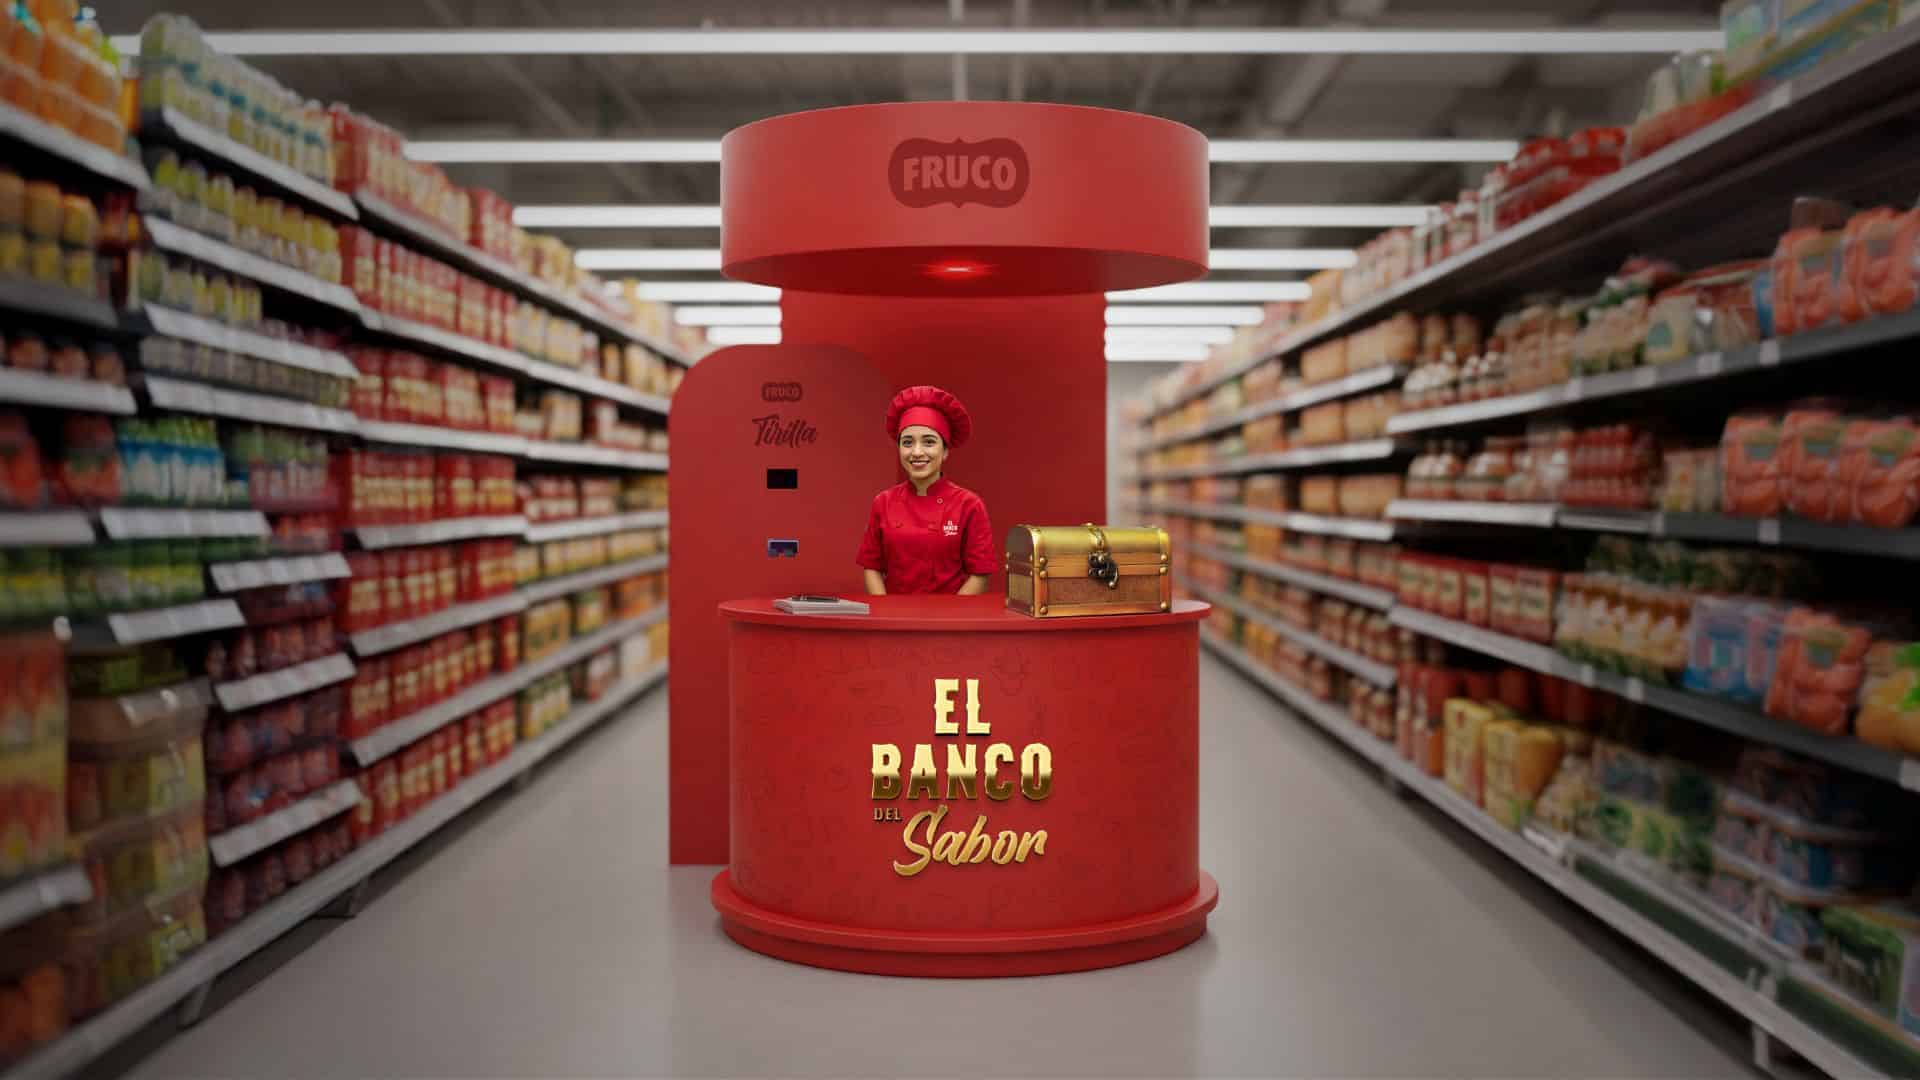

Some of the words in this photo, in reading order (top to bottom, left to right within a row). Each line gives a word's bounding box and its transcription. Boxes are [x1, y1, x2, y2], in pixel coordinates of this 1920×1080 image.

[904, 155, 1016, 191] FRUCO
[934, 678, 991, 735] EL
[871, 743, 1052, 799] BANCO
[874, 807, 901, 821] DEL
[893, 805, 1048, 876] Sabor
